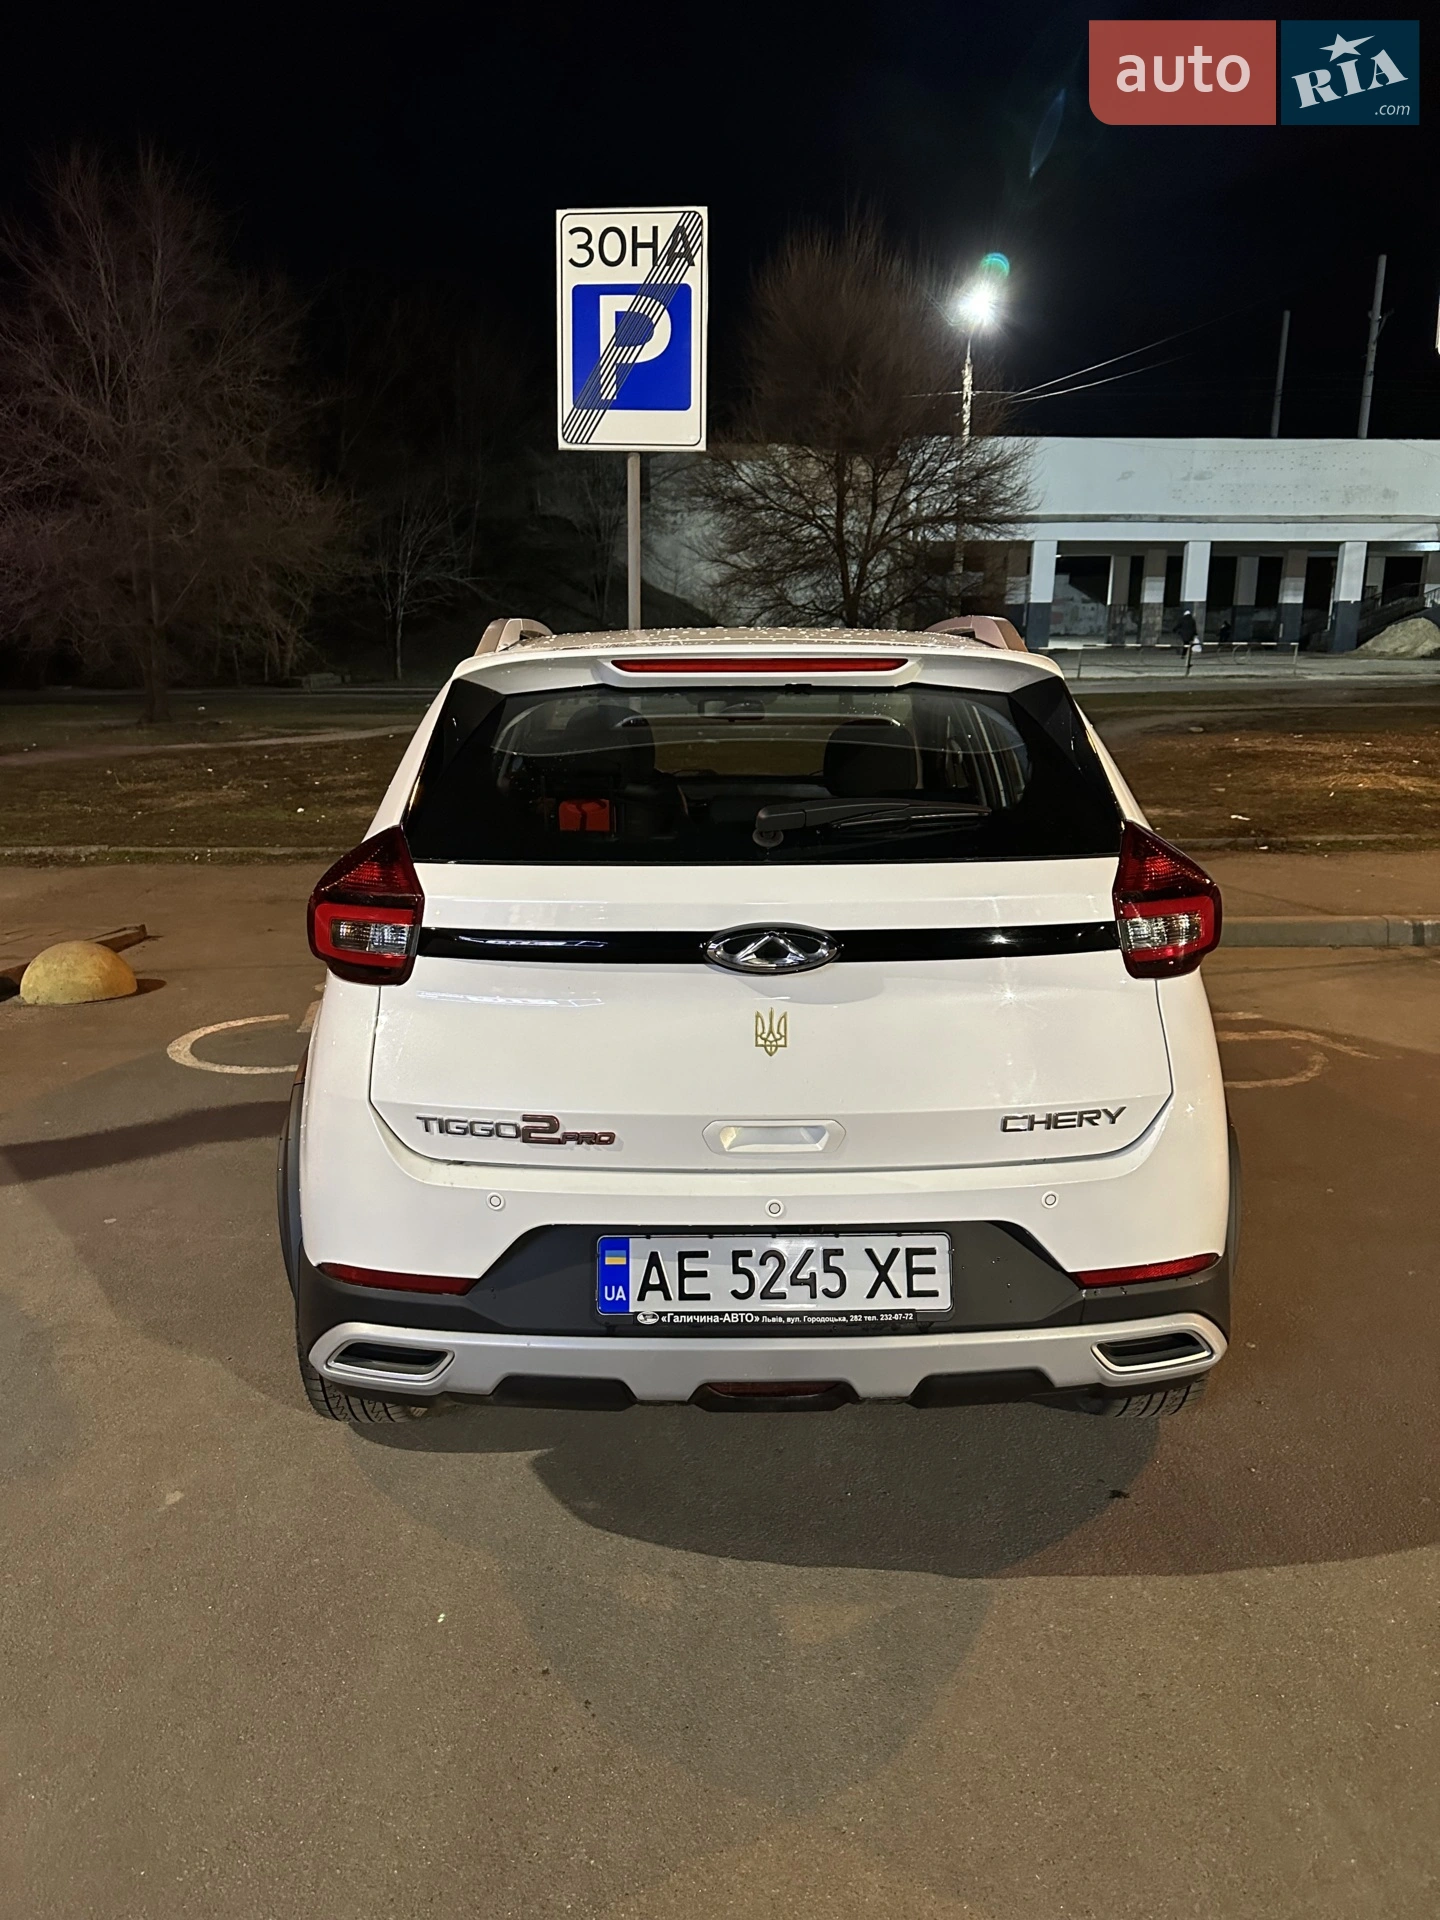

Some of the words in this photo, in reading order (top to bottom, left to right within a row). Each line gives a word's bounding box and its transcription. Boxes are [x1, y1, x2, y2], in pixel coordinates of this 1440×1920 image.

[568, 225, 696, 268] ЗОНА
[599, 294, 672, 400] P
[1000, 1106, 1127, 1133] CHERY
[636, 1250, 711, 1302] AE
[730, 1248, 847, 1300] 5245
[864, 1247, 939, 1299] XE
[604, 1285, 627, 1301] UA
[849, 1314, 863, 1322] 282
[880, 1312, 914, 1321] 232-07-72
